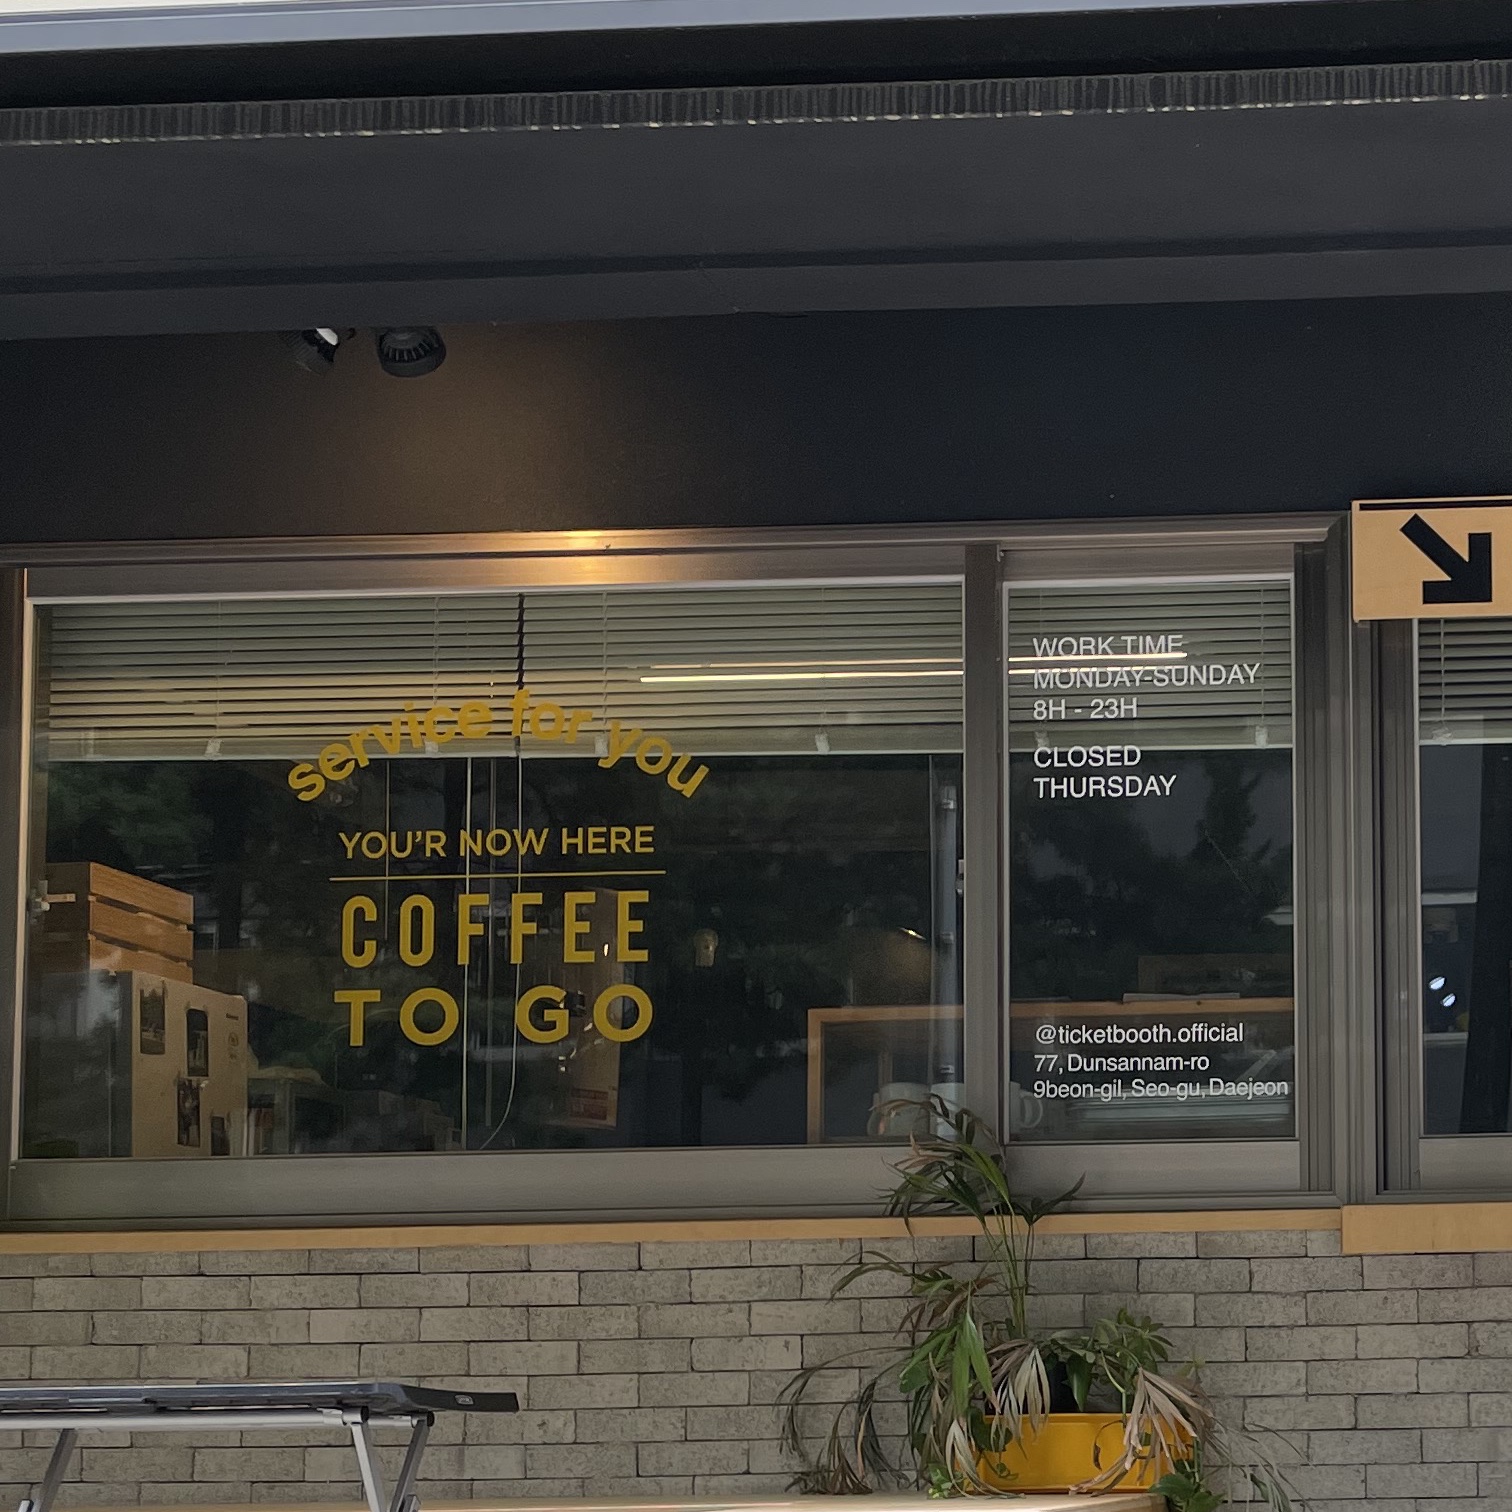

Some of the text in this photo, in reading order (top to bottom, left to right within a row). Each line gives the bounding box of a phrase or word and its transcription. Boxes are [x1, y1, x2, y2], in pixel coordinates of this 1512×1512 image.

[1032, 635, 1184, 657] WORK TIME
[1033, 663, 1261, 690] MONDAY-SUNDAY
[1033, 699, 1067, 721] 8H
[1089, 697, 1139, 719] 23H
[287, 688, 711, 802] service for you
[1033, 745, 1142, 768] CLOSED
[1033, 775, 1178, 799] THURSDAY
[338, 825, 656, 859] YOU'R NOW HERE
[341, 889, 651, 969] COFFEE
[333, 984, 654, 1048] TO GO
[1035, 1022, 1245, 1045] @ticketbooth.official
[1033, 1053, 1210, 1075] 77, Dunsannam-ro
[1033, 1077, 1289, 1102] 9beon-gil, Seo-gu, Daejeon
